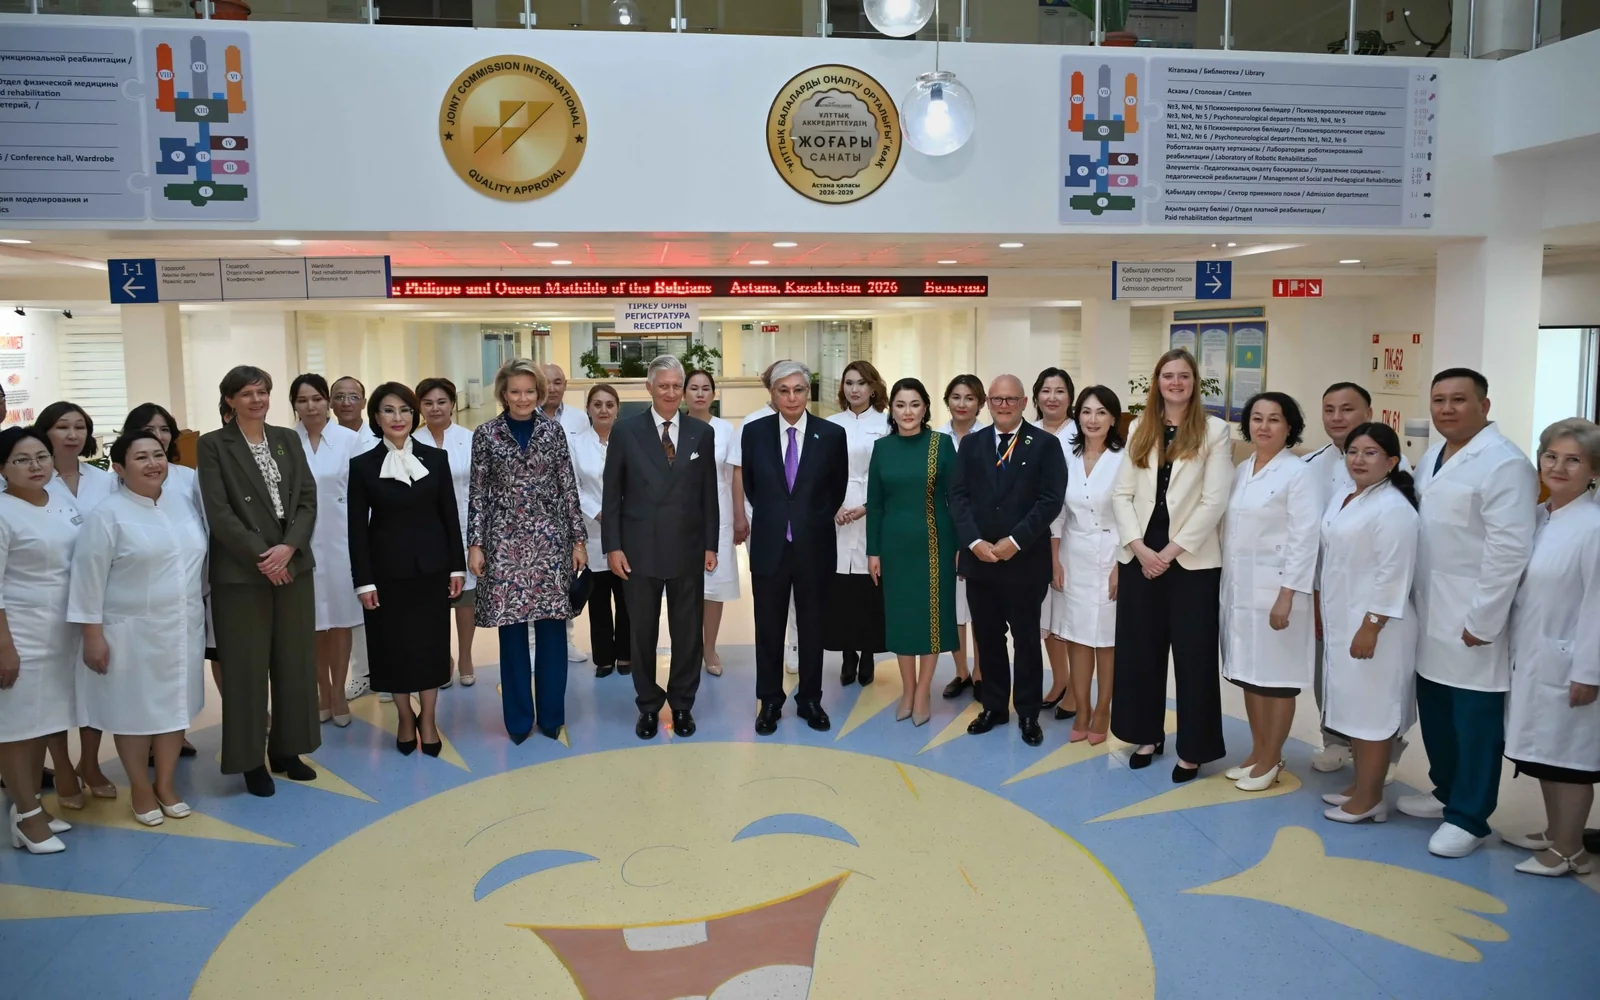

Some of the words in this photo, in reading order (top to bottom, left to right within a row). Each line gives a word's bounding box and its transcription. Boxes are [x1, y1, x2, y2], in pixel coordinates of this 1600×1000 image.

[67, 55, 126, 64] реабилитации
[1245, 69, 1265, 77] Library
[23, 79, 72, 87] физической
[7, 89, 60, 97] rehabilitation
[447, 94, 461, 125] JOINT
[458, 62, 520, 94] COMMISSION
[523, 63, 581, 128] INTERNATIONAL
[778, 78, 821, 127] БАЛАЛАРДЫ
[1214, 114, 1268, 122] Psychoneurological
[799, 136, 872, 148] ЖОҒАРЫ
[1215, 134, 1269, 142] Psychoneurological
[11, 154, 53, 162] Conference
[56, 154, 73, 163] hall,
[810, 153, 861, 162] САНАТЫ
[468, 169, 511, 194] QUALITY
[513, 169, 566, 194] APPROVAL
[122, 263, 143, 276] I-1
[1206, 263, 1222, 273] I-1
[404, 282, 461, 295] Philippe
[466, 282, 490, 294] and
[545, 282, 607, 294] Mathilde
[612, 282, 626, 294] of
[630, 282, 650, 294] the
[731, 282, 781, 294] Astana,
[784, 282, 861, 293] Kazakhstan
[868, 282, 898, 293] 2026
[625, 312, 690, 320] РЕГИСТРАТУРА
[634, 322, 682, 330] RECEPTION
[1384, 348, 1403, 371] ПК-62
